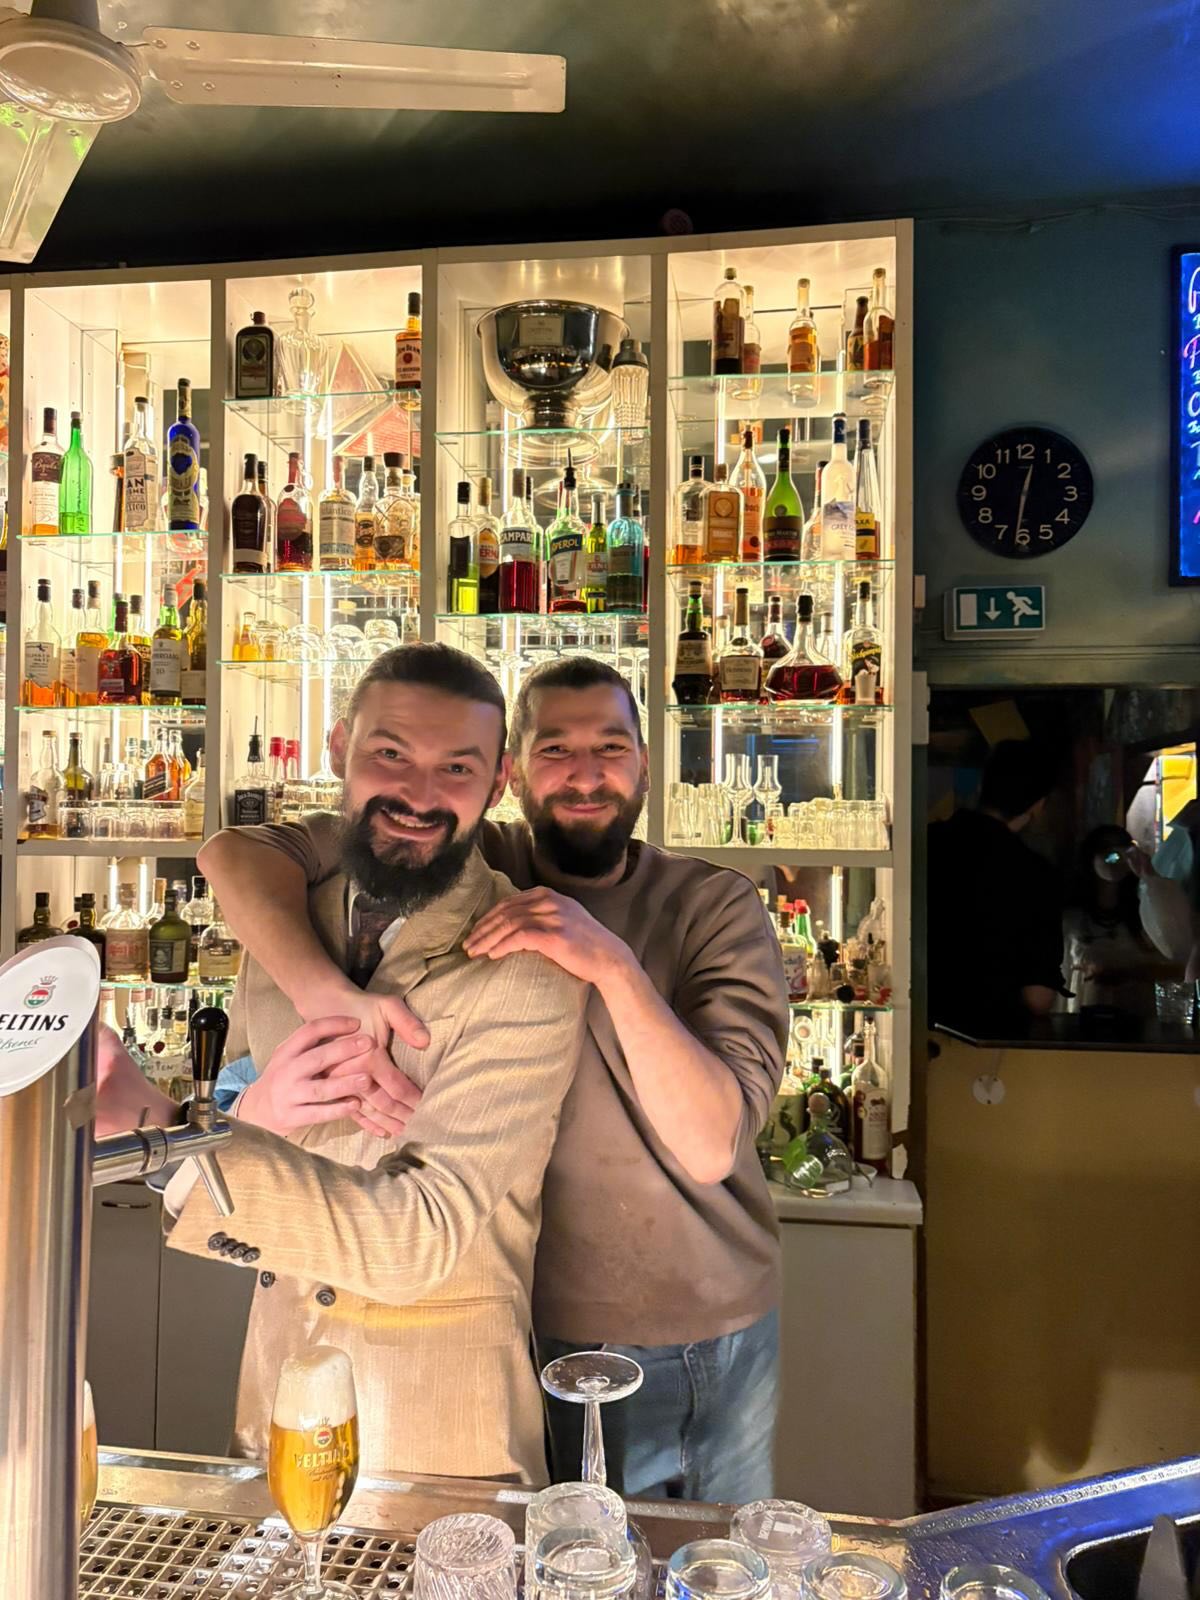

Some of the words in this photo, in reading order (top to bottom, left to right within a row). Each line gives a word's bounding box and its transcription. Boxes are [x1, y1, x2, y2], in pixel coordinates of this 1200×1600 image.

[996, 449, 1010, 464] 11
[1016, 444, 1035, 460] 12
[1044, 449, 1051, 464] 1
[977, 463, 996, 479] 10
[1057, 463, 1071, 479] 2
[127, 478, 144, 488] AN
[971, 485, 987, 501] 9
[1063, 486, 1078, 501] 3
[977, 507, 993, 524] 8
[1055, 508, 1070, 524] 4
[994, 524, 1008, 540] 7
[1015, 529, 1030, 545] 6
[1038, 524, 1053, 540] 5
[0, 1013, 69, 1031] ELTINS
